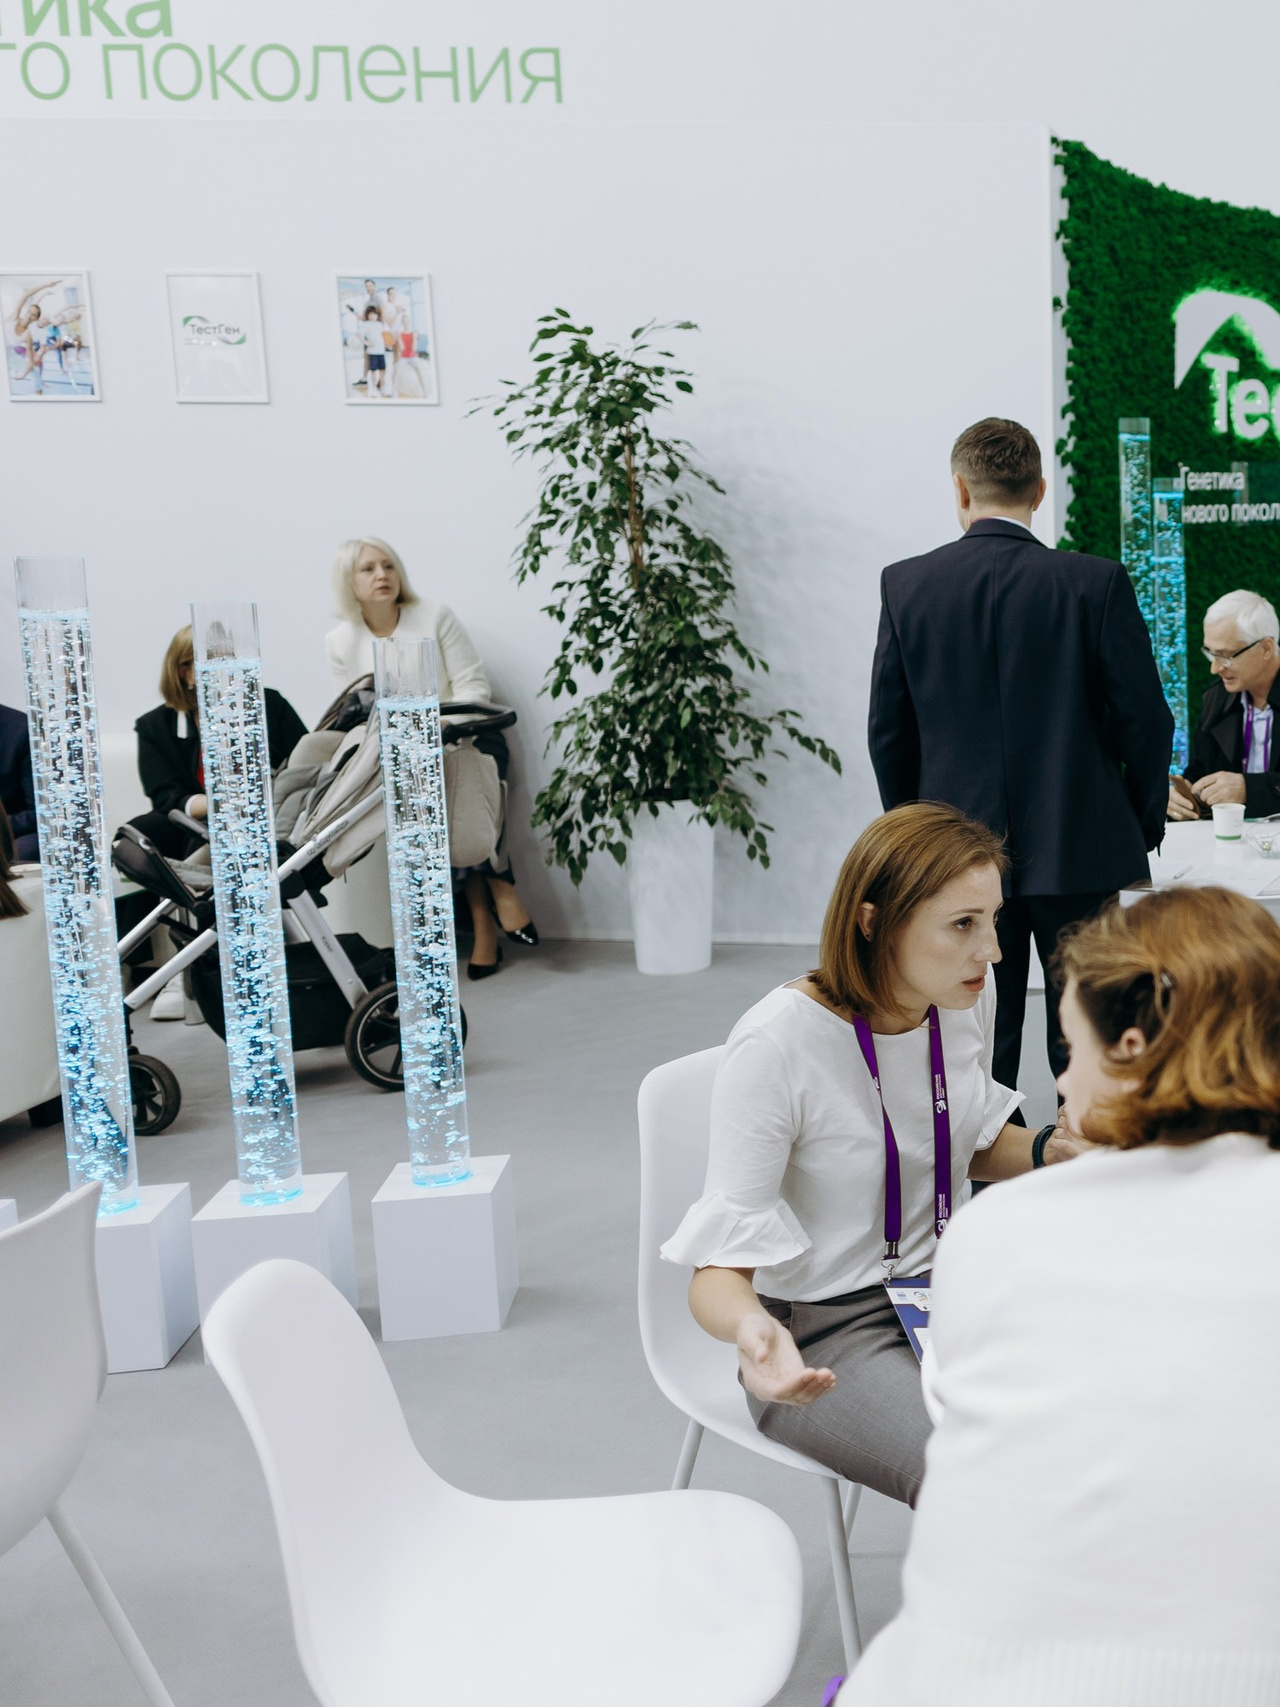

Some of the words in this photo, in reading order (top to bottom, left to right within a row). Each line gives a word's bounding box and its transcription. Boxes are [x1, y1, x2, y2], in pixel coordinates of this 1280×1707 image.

[0, 0, 173, 38] ика
[101, 42, 564, 104] поколения
[189, 323, 241, 335] ТестГен
[1180, 466, 1246, 491] Генетика
[1182, 503, 1230, 524] нового
